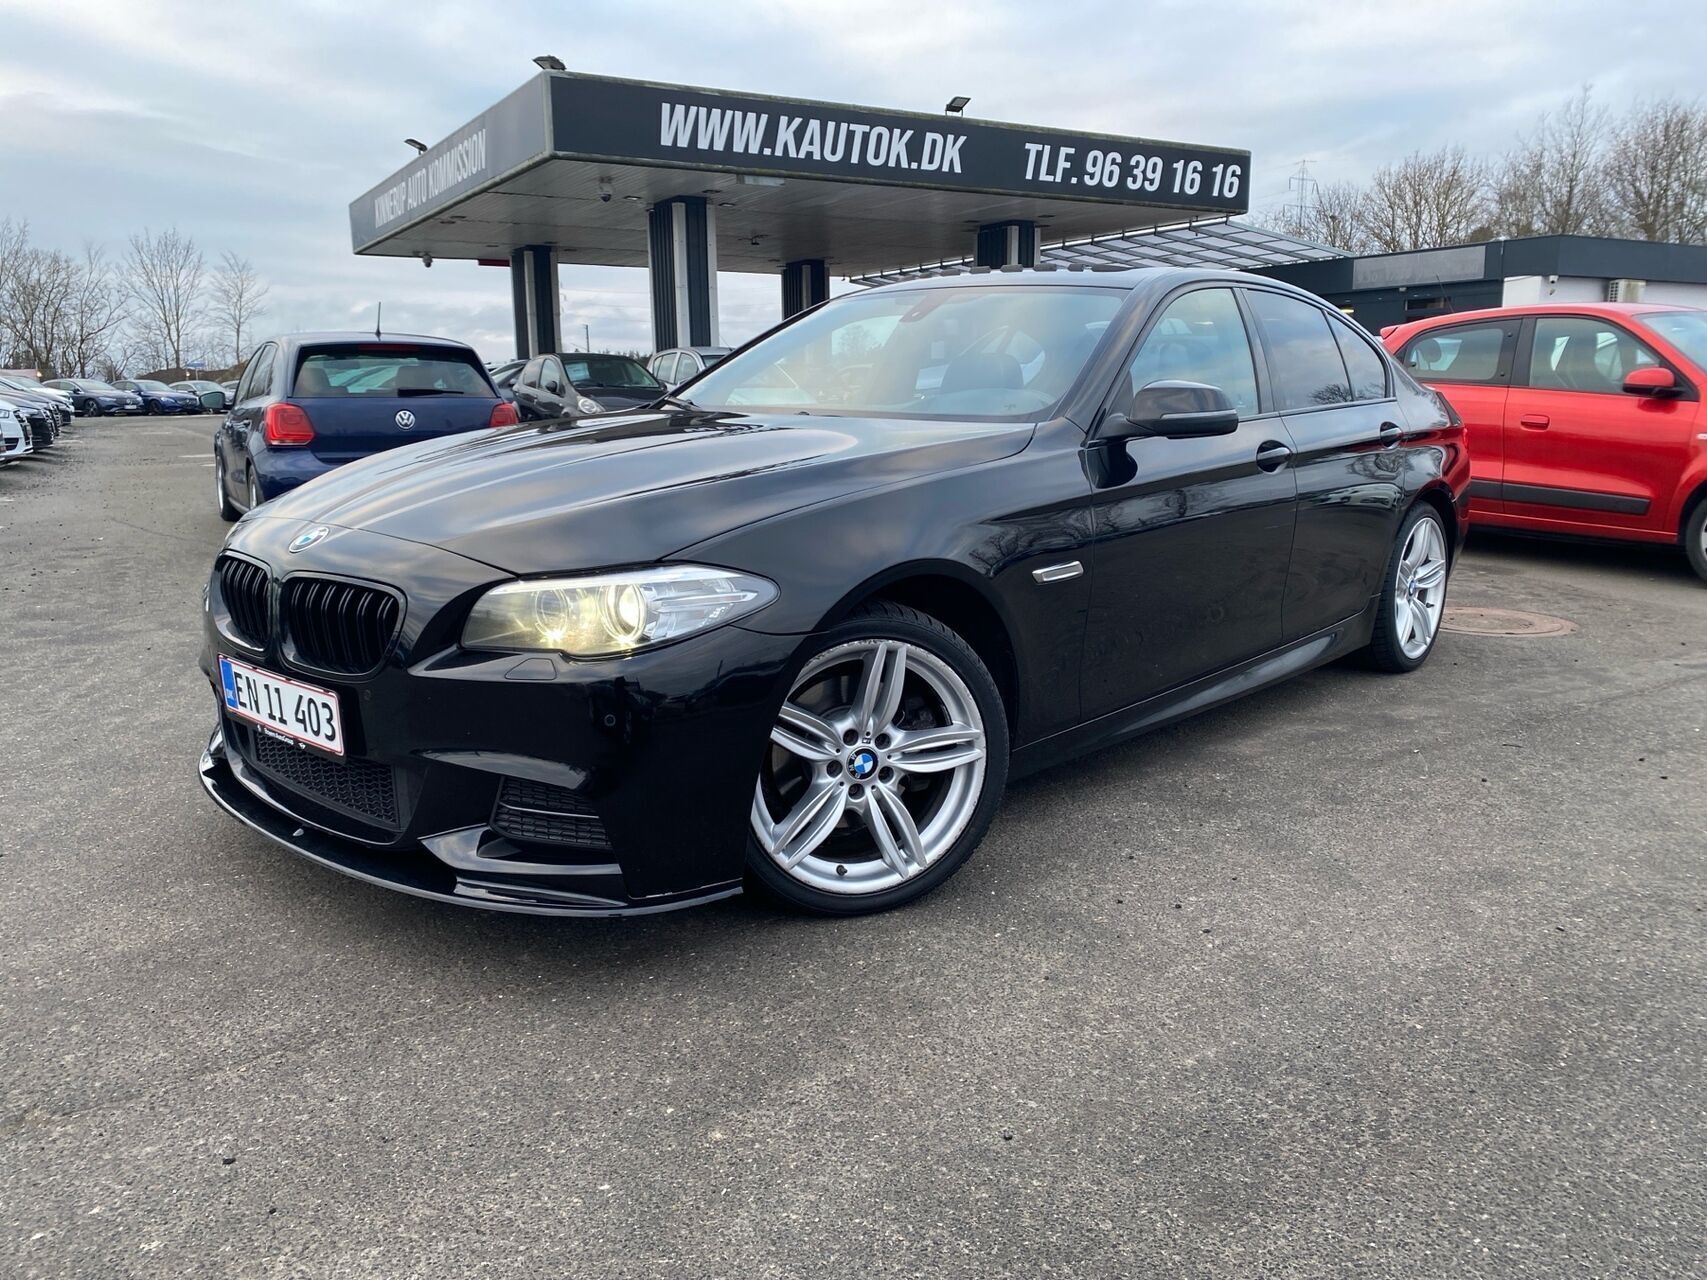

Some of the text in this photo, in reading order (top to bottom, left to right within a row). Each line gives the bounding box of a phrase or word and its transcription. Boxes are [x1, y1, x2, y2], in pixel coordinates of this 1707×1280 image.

[408, 167, 427, 210] AUTO
[428, 128, 486, 199] KOMMISSION
[661, 102, 967, 174] WWW.KAUTOK.DK
[1025, 143, 1241, 199] TLF. 96 39 16 16
[233, 671, 260, 715] EN
[264, 684, 287, 726] 11
[295, 694, 336, 742] 403
